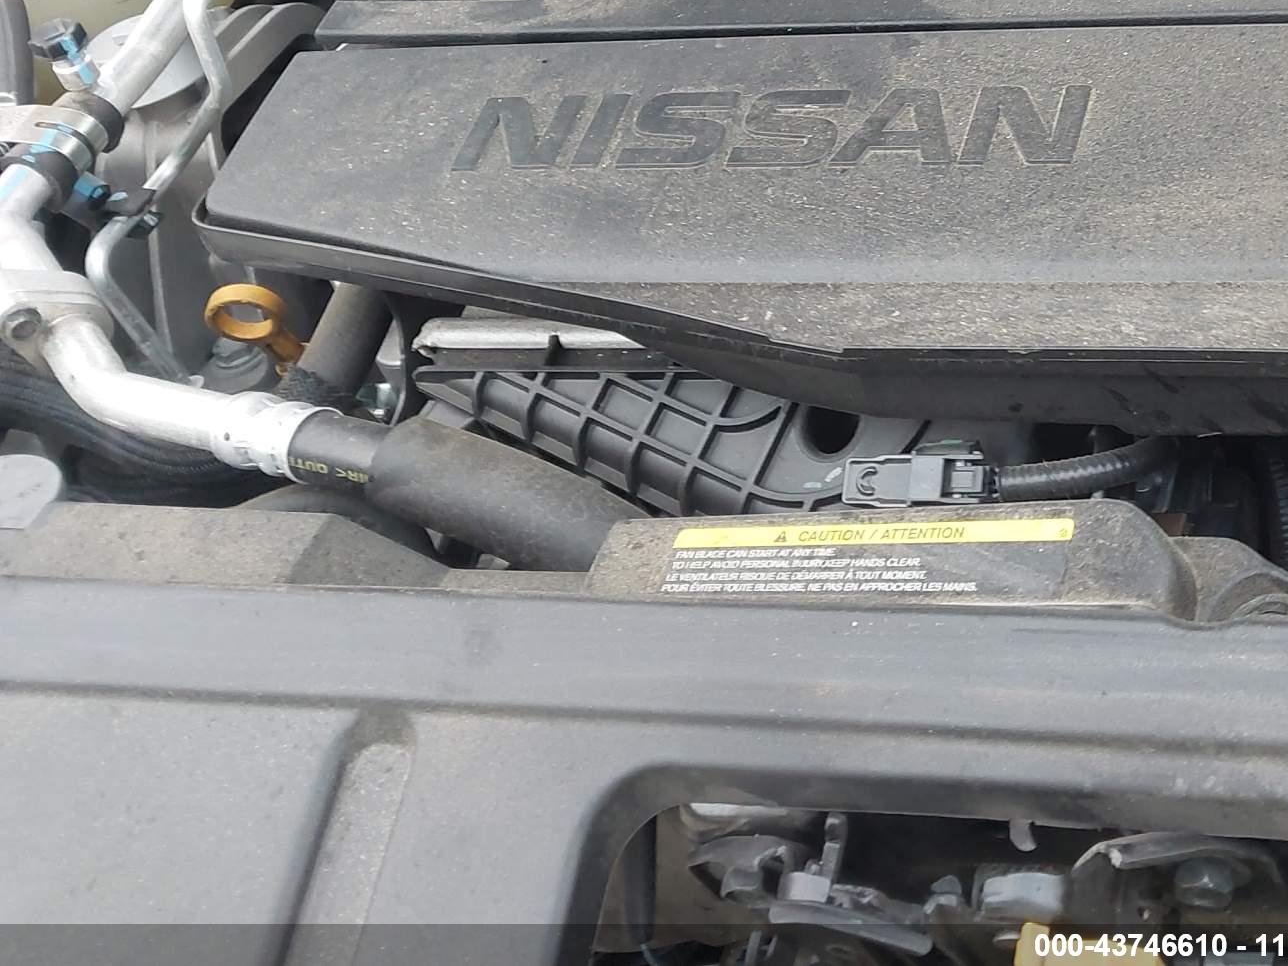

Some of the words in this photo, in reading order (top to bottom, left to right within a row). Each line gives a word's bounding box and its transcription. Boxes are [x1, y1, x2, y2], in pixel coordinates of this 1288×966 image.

[451, 84, 1093, 172] NISSAN
[798, 529, 865, 542] CAUTION
[869, 529, 878, 540] /
[880, 527, 965, 540] ATTENTION
[675, 550, 694, 559] FAN
[726, 550, 748, 558] CAN
[778, 549, 792, 557] AT
[672, 561, 685, 569] TO
[740, 560, 792, 568] PERSONAL
[850, 559, 886, 567] HANDS
[665, 573, 680, 582] LE
[740, 572, 776, 581] RISQUE
[776, 572, 791, 580] DE
[855, 571, 882, 579] TOUT
[661, 583, 690, 592] POUR
[723, 583, 754, 592] TOUTE
[807, 583, 823, 591] NE
[823, 583, 844, 591] PAS
[843, 582, 860, 591] EN
[859, 582, 922, 591] APPROCHER
[922, 582, 943, 591] LES
